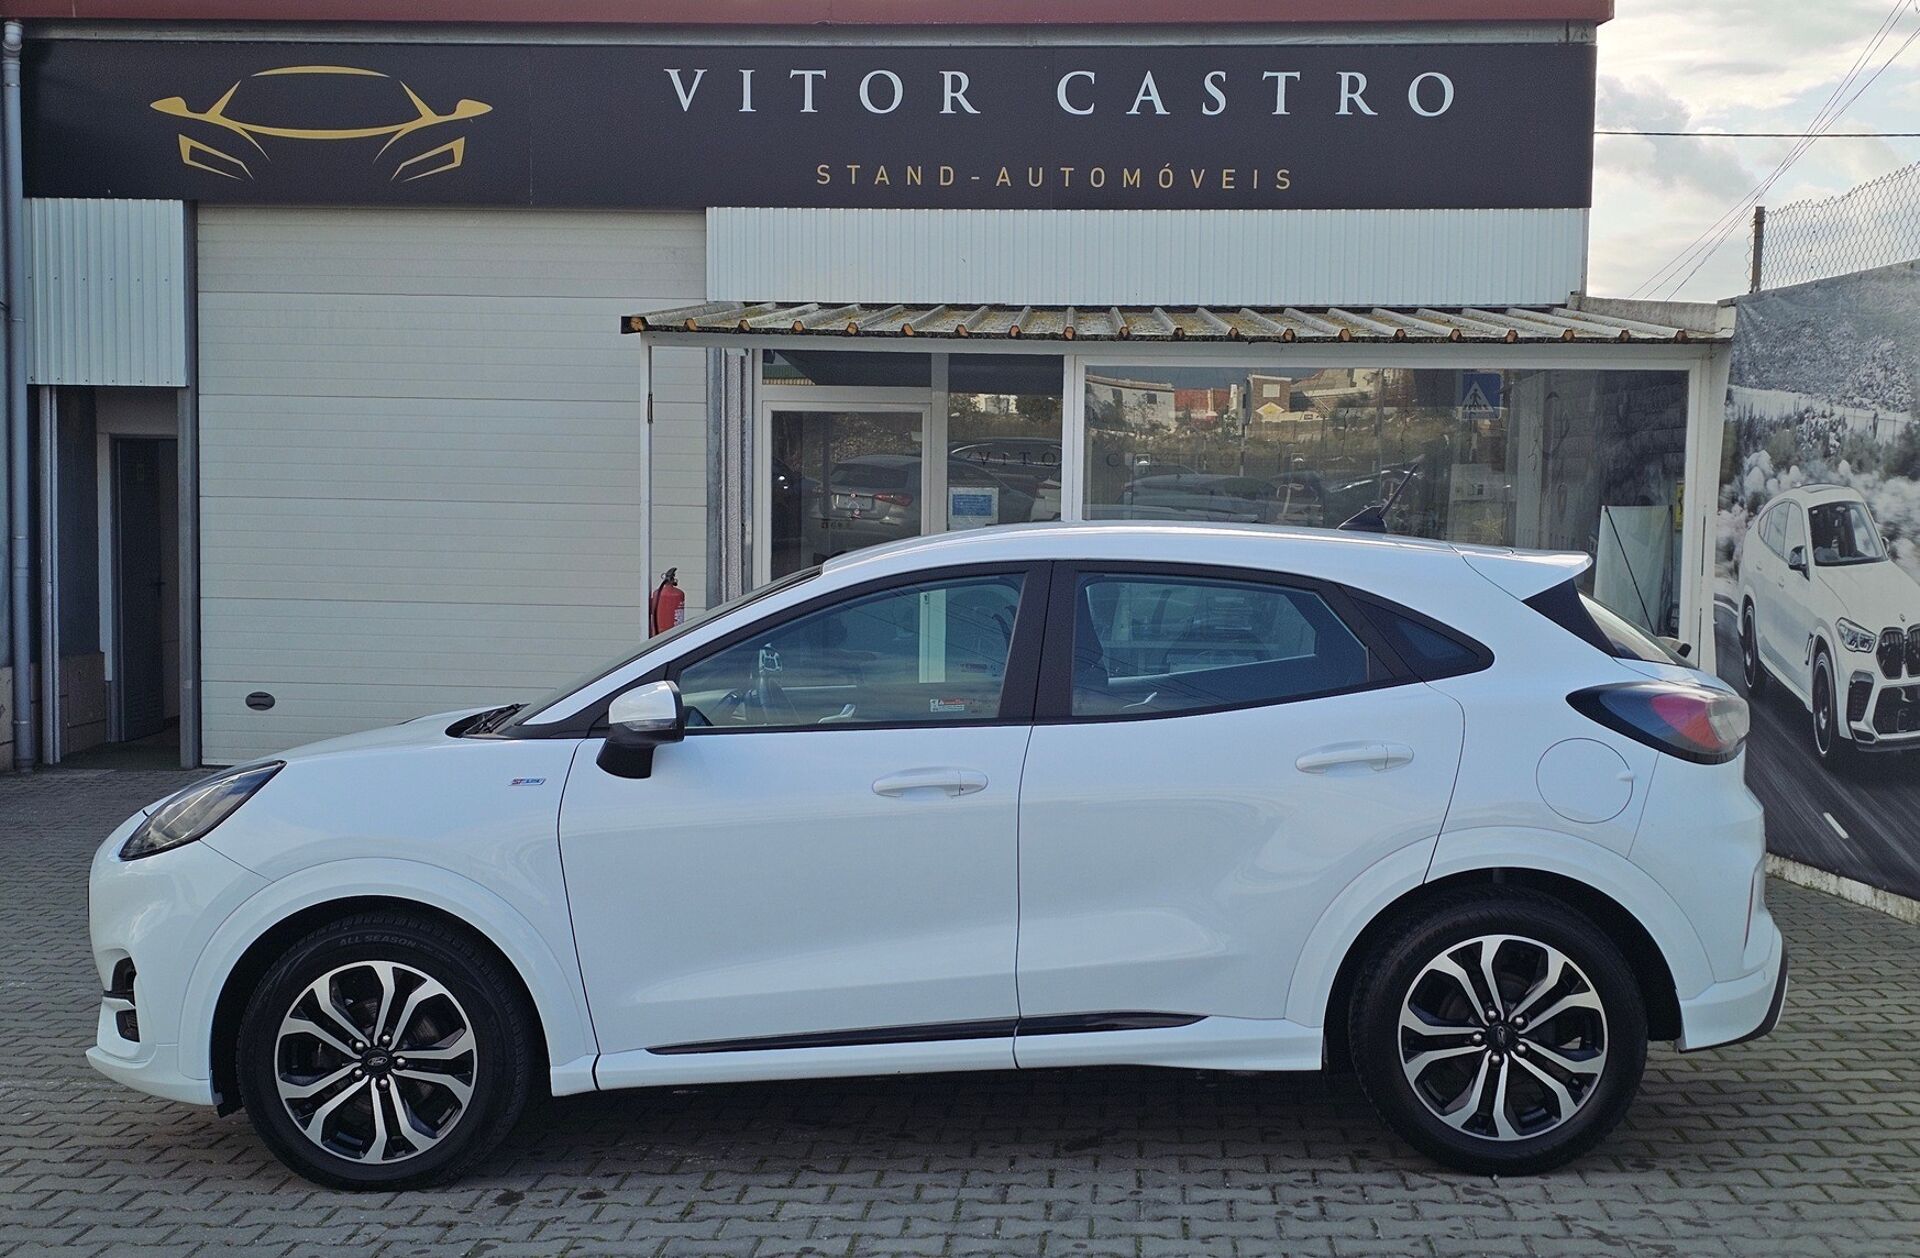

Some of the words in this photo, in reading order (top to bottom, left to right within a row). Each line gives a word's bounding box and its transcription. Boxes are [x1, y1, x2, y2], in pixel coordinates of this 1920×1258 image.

[663, 68, 983, 115] VITOR
[1056, 70, 1456, 118] CASTRO
[816, 163, 1292, 190] STAND-AUTOMÓVEIS
[976, 451, 1057, 467] VITO
[339, 935, 362, 946] ALL
[364, 934, 417, 948] SEASON
